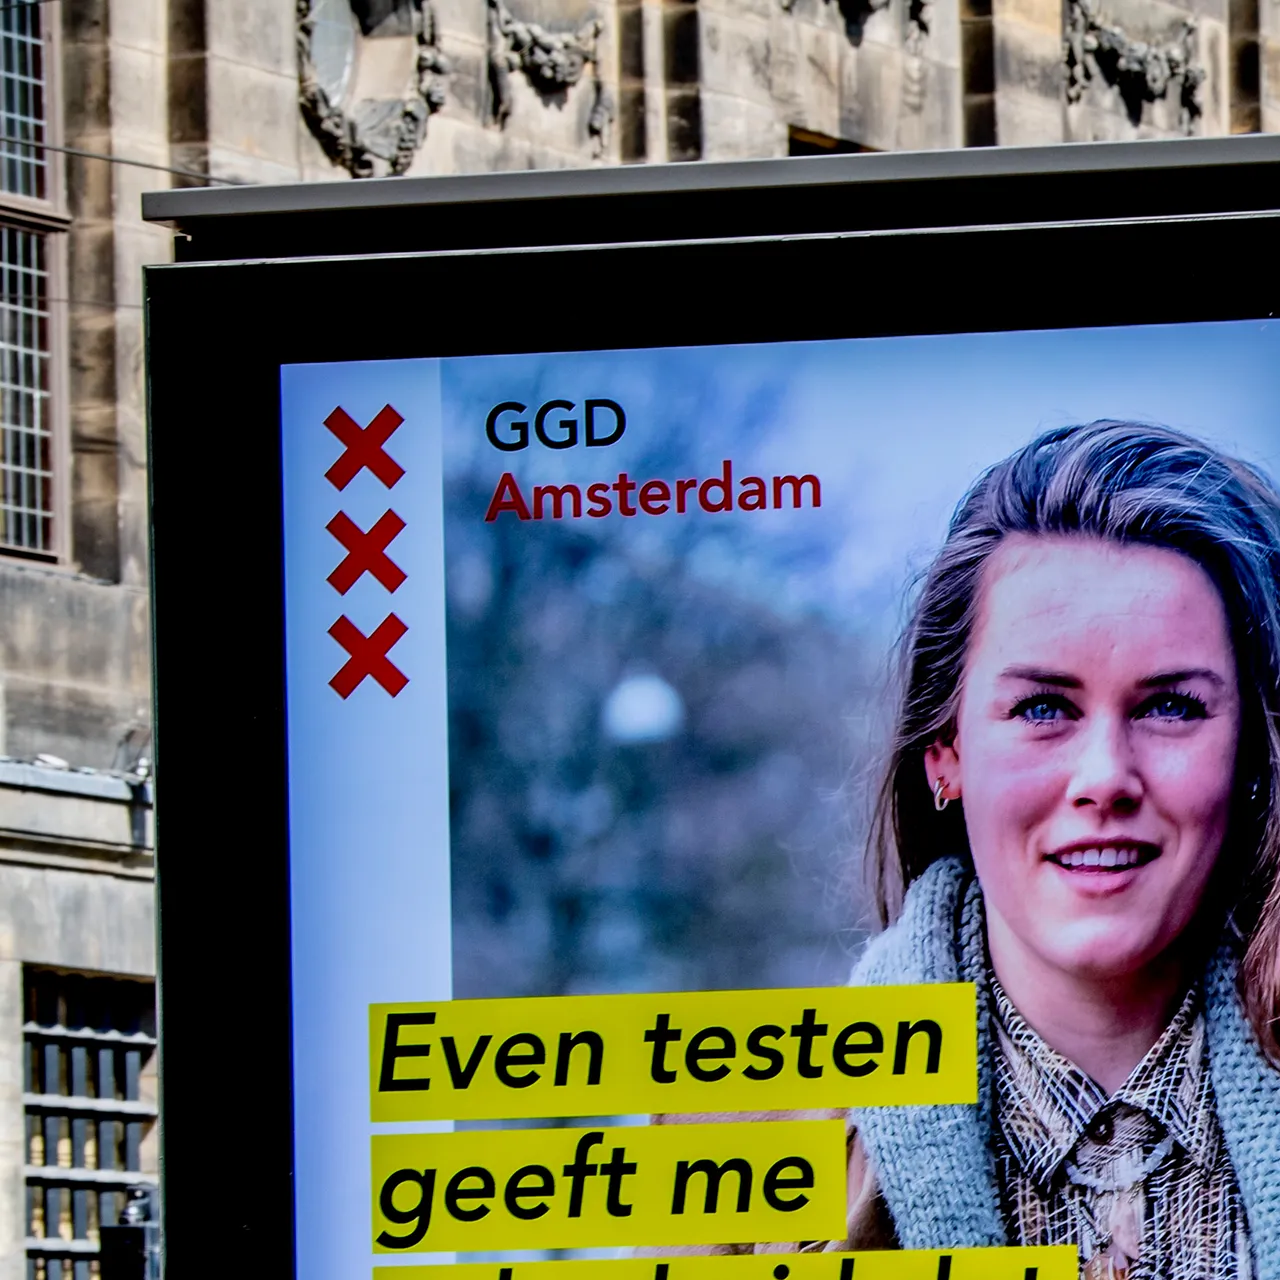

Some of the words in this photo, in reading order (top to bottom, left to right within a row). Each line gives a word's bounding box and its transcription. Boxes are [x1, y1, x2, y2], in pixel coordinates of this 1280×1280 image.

[486, 399, 626, 451] GGD
[484, 460, 822, 522] Amsterdam
[379, 1012, 603, 1092] Even
[644, 1009, 942, 1083] testen
[375, 1132, 637, 1249] geeft
[671, 1157, 814, 1214] me
